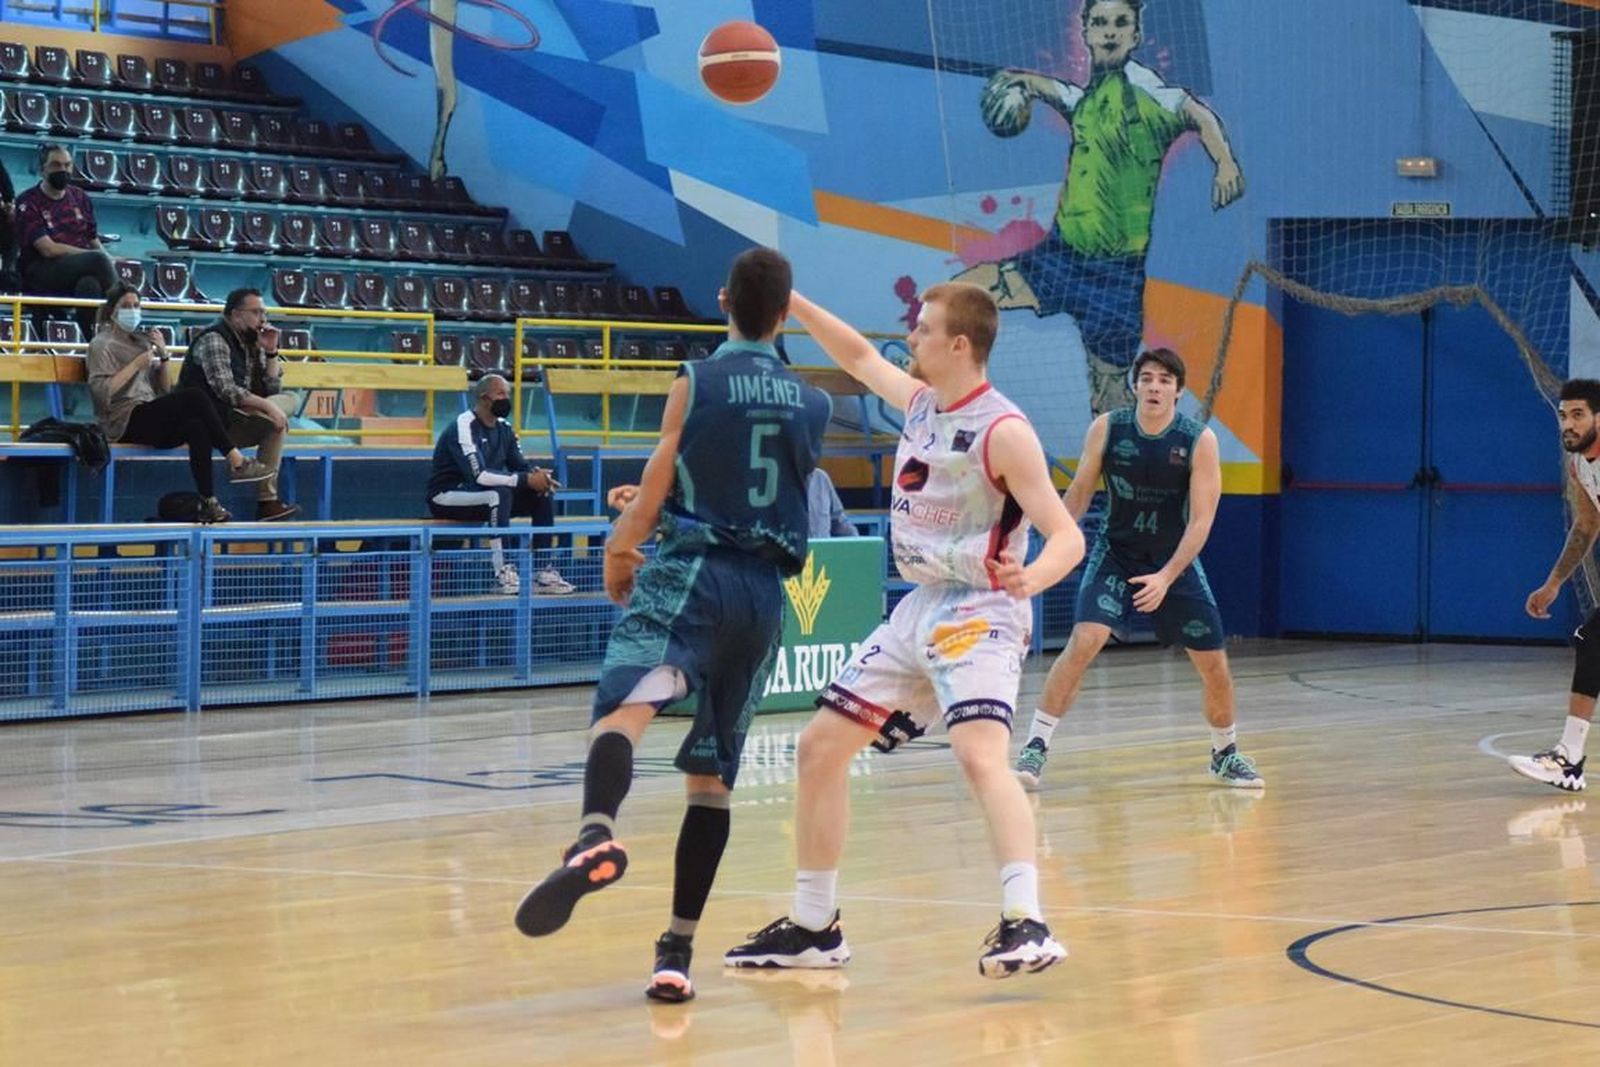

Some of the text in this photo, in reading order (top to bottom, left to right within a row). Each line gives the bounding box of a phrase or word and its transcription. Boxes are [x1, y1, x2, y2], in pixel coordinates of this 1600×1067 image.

[166, 269, 176, 280] 61
[289, 336, 299, 347] 61
[727, 371, 806, 409] JIMÉNEZ
[748, 424, 781, 508] 5
[1133, 510, 1159, 536] 44
[860, 645, 881, 665] 2
[961, 704, 979, 718] ZMR
